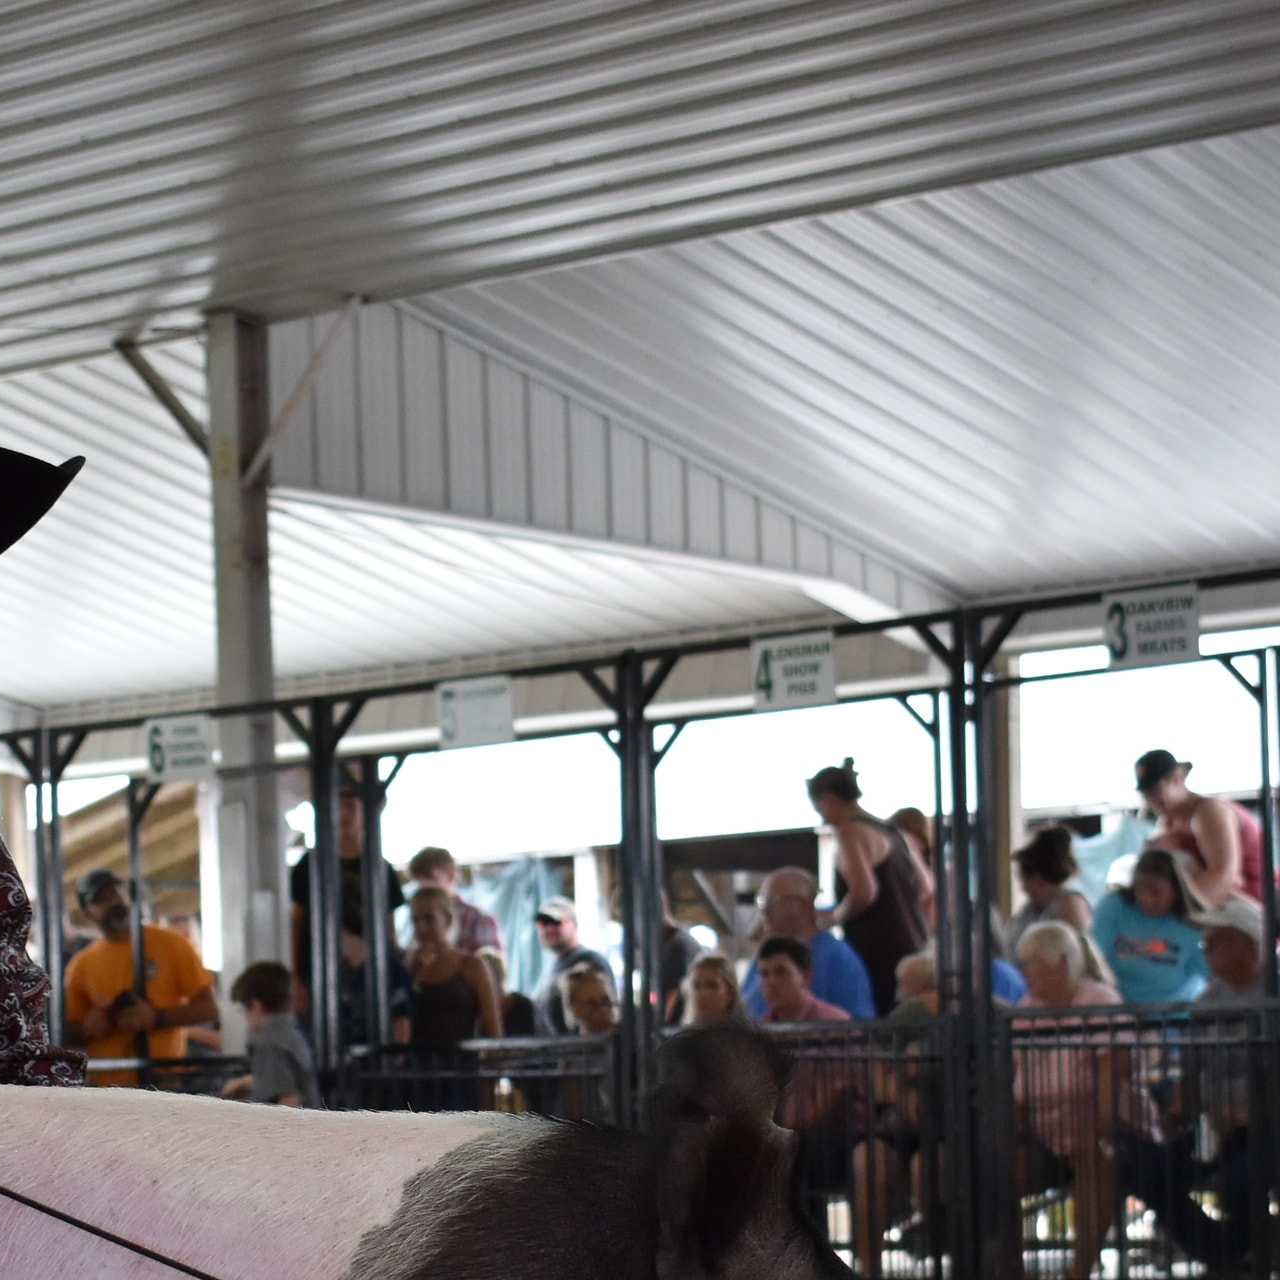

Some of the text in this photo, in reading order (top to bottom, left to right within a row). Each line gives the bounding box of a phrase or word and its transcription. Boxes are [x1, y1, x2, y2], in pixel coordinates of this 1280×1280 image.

[1106, 602, 1129, 660] 3
[1136, 617, 1187, 635] FARMS
[1137, 637, 1187, 656] MEATS
[756, 647, 772, 702] 4
[782, 662, 820, 678] SHOW
[786, 681, 817, 697] PIGS
[149, 726, 164, 774] 6
